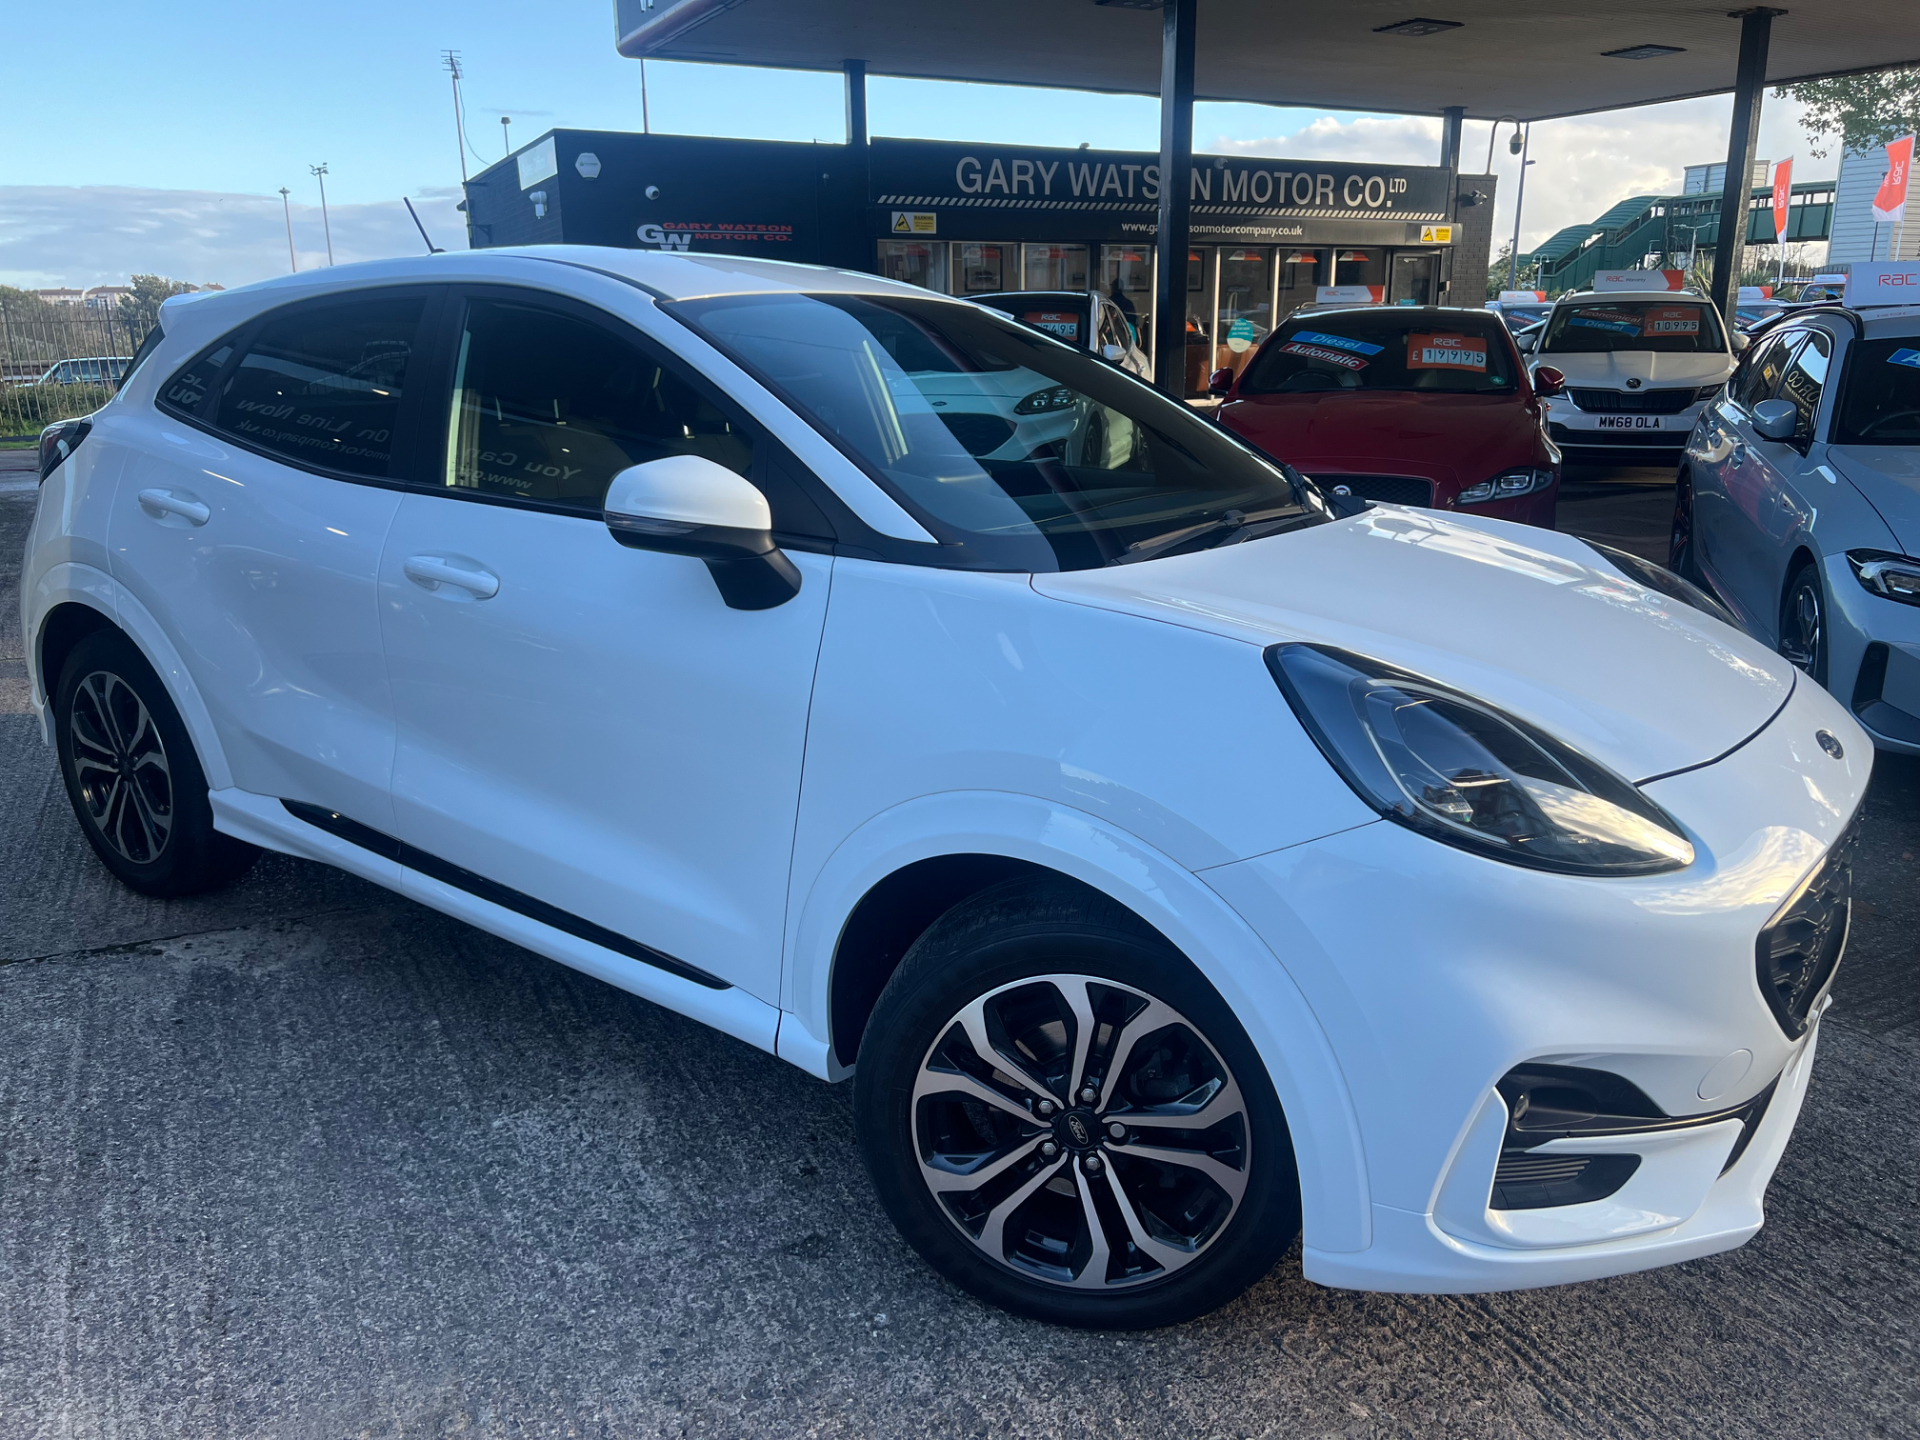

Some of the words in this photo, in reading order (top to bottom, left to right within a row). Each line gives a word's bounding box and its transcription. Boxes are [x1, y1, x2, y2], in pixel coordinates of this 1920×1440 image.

[956, 156, 1059, 195] GARY
[1067, 161, 1211, 202] WATSN
[1222, 168, 1334, 206] MOTOR
[1344, 174, 1392, 208] CO.
[1389, 178, 1407, 193] LTD
[662, 222, 712, 230] GARY
[718, 223, 793, 232] WATSON
[1121, 222, 1303, 238] www.gasonmotorcompany.co.uk
[1579, 309, 1641, 323] Economical
[1040, 324, 1077, 335] 7495
[1585, 320, 1623, 331] Diesel
[1655, 321, 1698, 331] 10995
[1311, 334, 1361, 349] Diesel
[1287, 344, 1360, 367] Automatic
[1426, 349, 1484, 363] 19995
[1599, 416, 1633, 428] MW68
[1635, 416, 1660, 428] OLA
